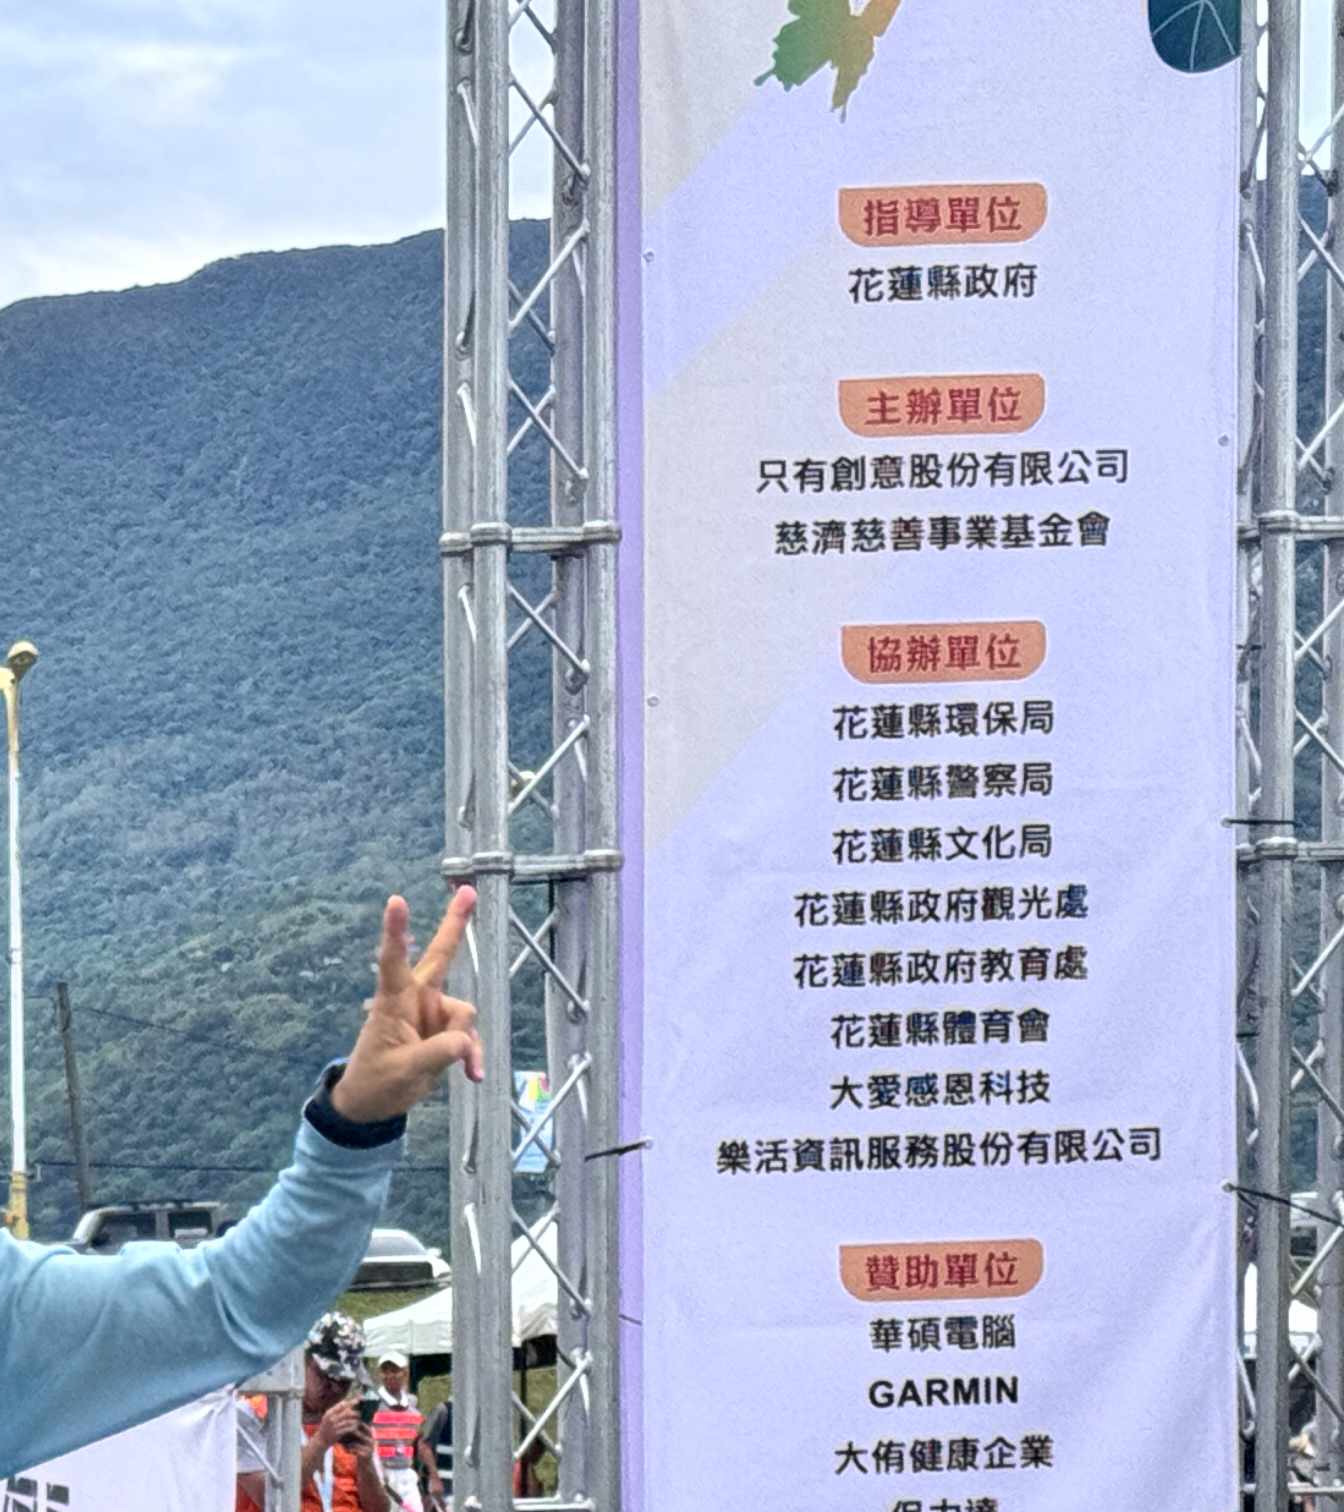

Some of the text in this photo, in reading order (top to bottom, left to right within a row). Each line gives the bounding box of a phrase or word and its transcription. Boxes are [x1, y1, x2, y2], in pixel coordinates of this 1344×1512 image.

[863, 196, 1022, 237] 指導單位
[848, 262, 1037, 304] 花蓮縣政府
[865, 386, 1022, 426] 主辦單位
[756, 449, 1129, 494] 只有創意股份有限公司
[775, 510, 1110, 556] 慈濟慈善事業基金會
[868, 633, 1021, 673] 協辦單位
[832, 700, 1054, 741] 花蓮縣環保局
[833, 762, 1053, 802] 花蓮縣警察局
[832, 823, 1052, 865] 花蓮縣文化局
[794, 883, 1089, 927] 花蓮縣政府觀光處
[793, 944, 1087, 989] 花蓮縣政府教育處
[830, 1007, 1050, 1049] 花蓮縣體育會
[830, 1069, 1050, 1110] 大愛感恩科技
[716, 1127, 1161, 1175] 樂活資訊服務股份有限公司
[866, 1251, 1019, 1292] 贊助單位
[869, 1314, 1016, 1353] 華碩電腦
[868, 1375, 1019, 1409] GARMIN
[835, 1434, 1053, 1475] 大侑健康企業
